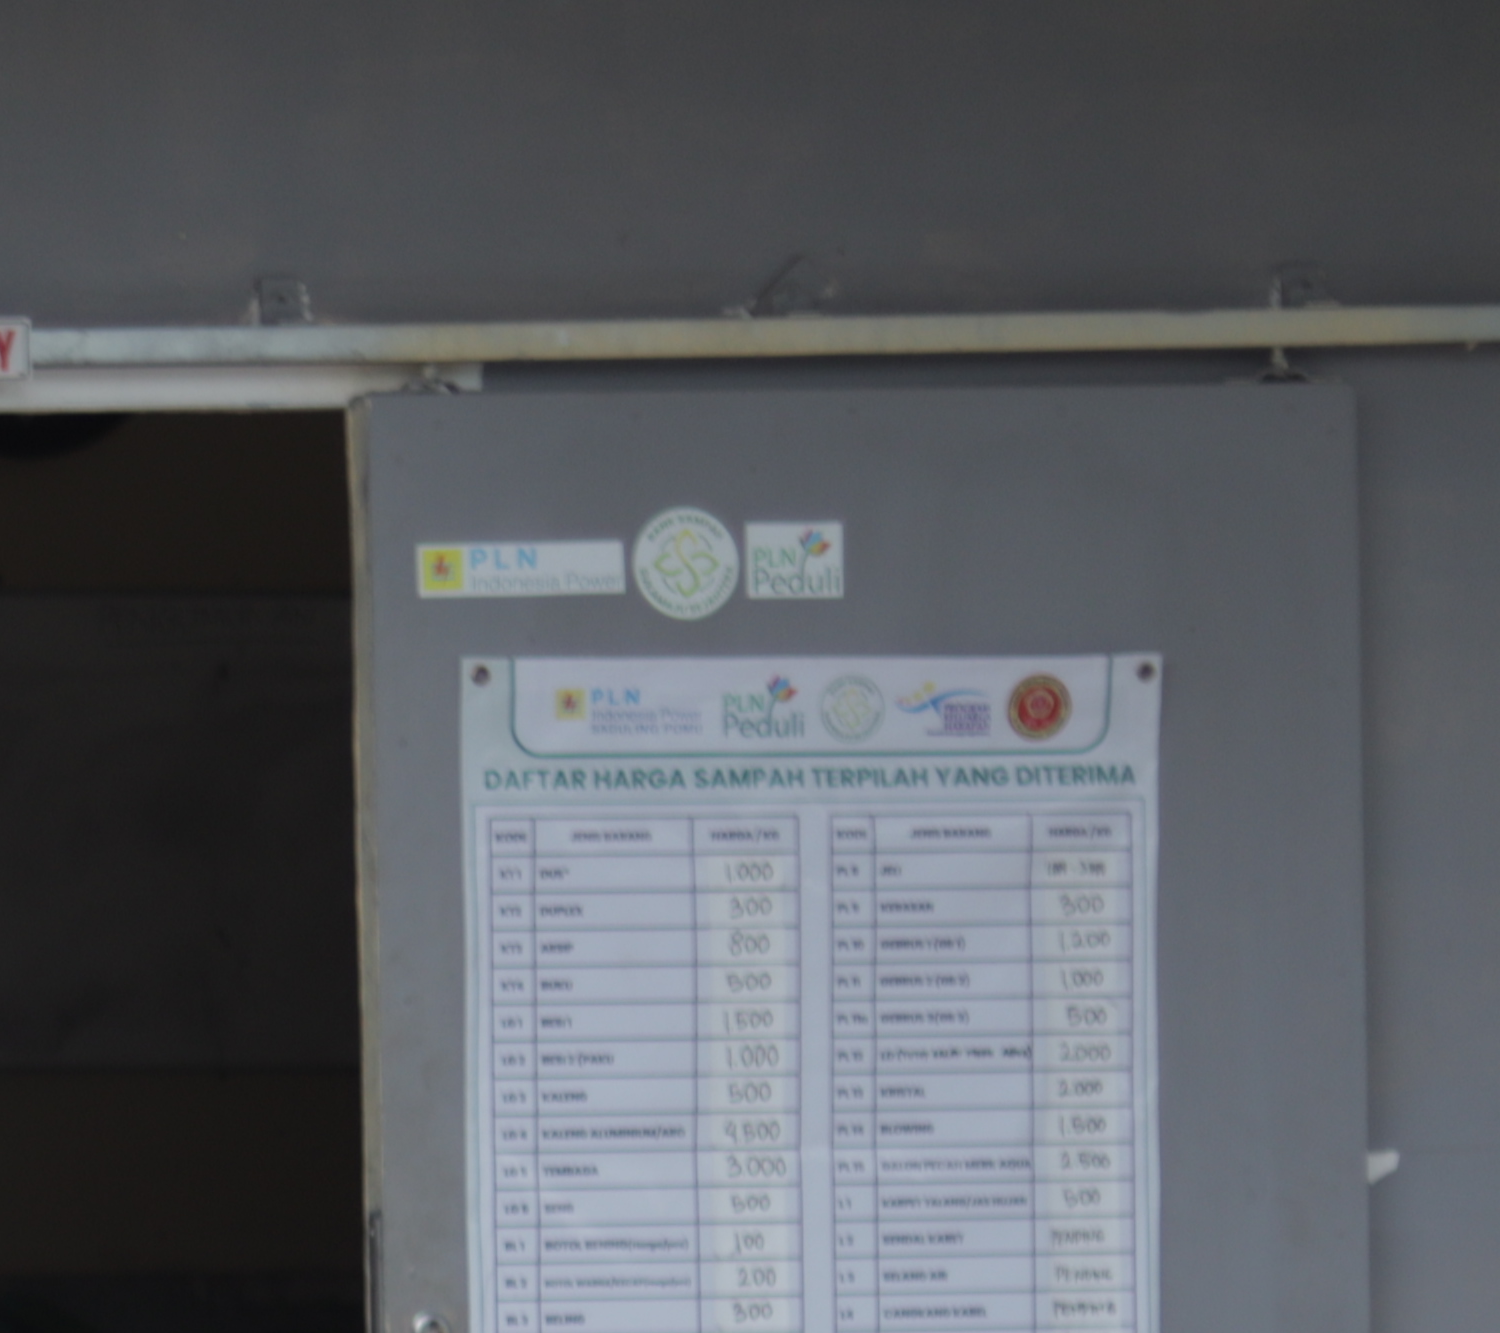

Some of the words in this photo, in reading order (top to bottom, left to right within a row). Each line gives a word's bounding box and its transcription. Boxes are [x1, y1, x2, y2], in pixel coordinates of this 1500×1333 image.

[469, 547, 538, 571] PLN
[753, 547, 799, 569] PLN
[469, 573, 562, 592] Indonesia
[753, 567, 842, 595] Peduli
[590, 687, 642, 706] PLN
[722, 711, 805, 739] Peduli
[484, 768, 587, 791] DAFTAR
[592, 768, 686, 790] HARGA
[692, 767, 805, 789] SAMPAH
[810, 766, 928, 789] TERPILAH
[936, 765, 1010, 787] YANG
[1014, 765, 1136, 787] DITERIMA
[725, 861, 775, 881] 1.000
[729, 897, 773, 920] 300
[729, 929, 771, 956] 800
[726, 971, 772, 992] 500
[722, 1010, 775, 1034] 1.500
[1066, 1004, 1109, 1028] 500
[725, 1044, 780, 1069] 1.000
[728, 1081, 772, 1103] 500
[731, 1193, 772, 1215] 500
[734, 1232, 765, 1256] 100
[737, 1267, 777, 1288] 200
[732, 1303, 774, 1324] 300
